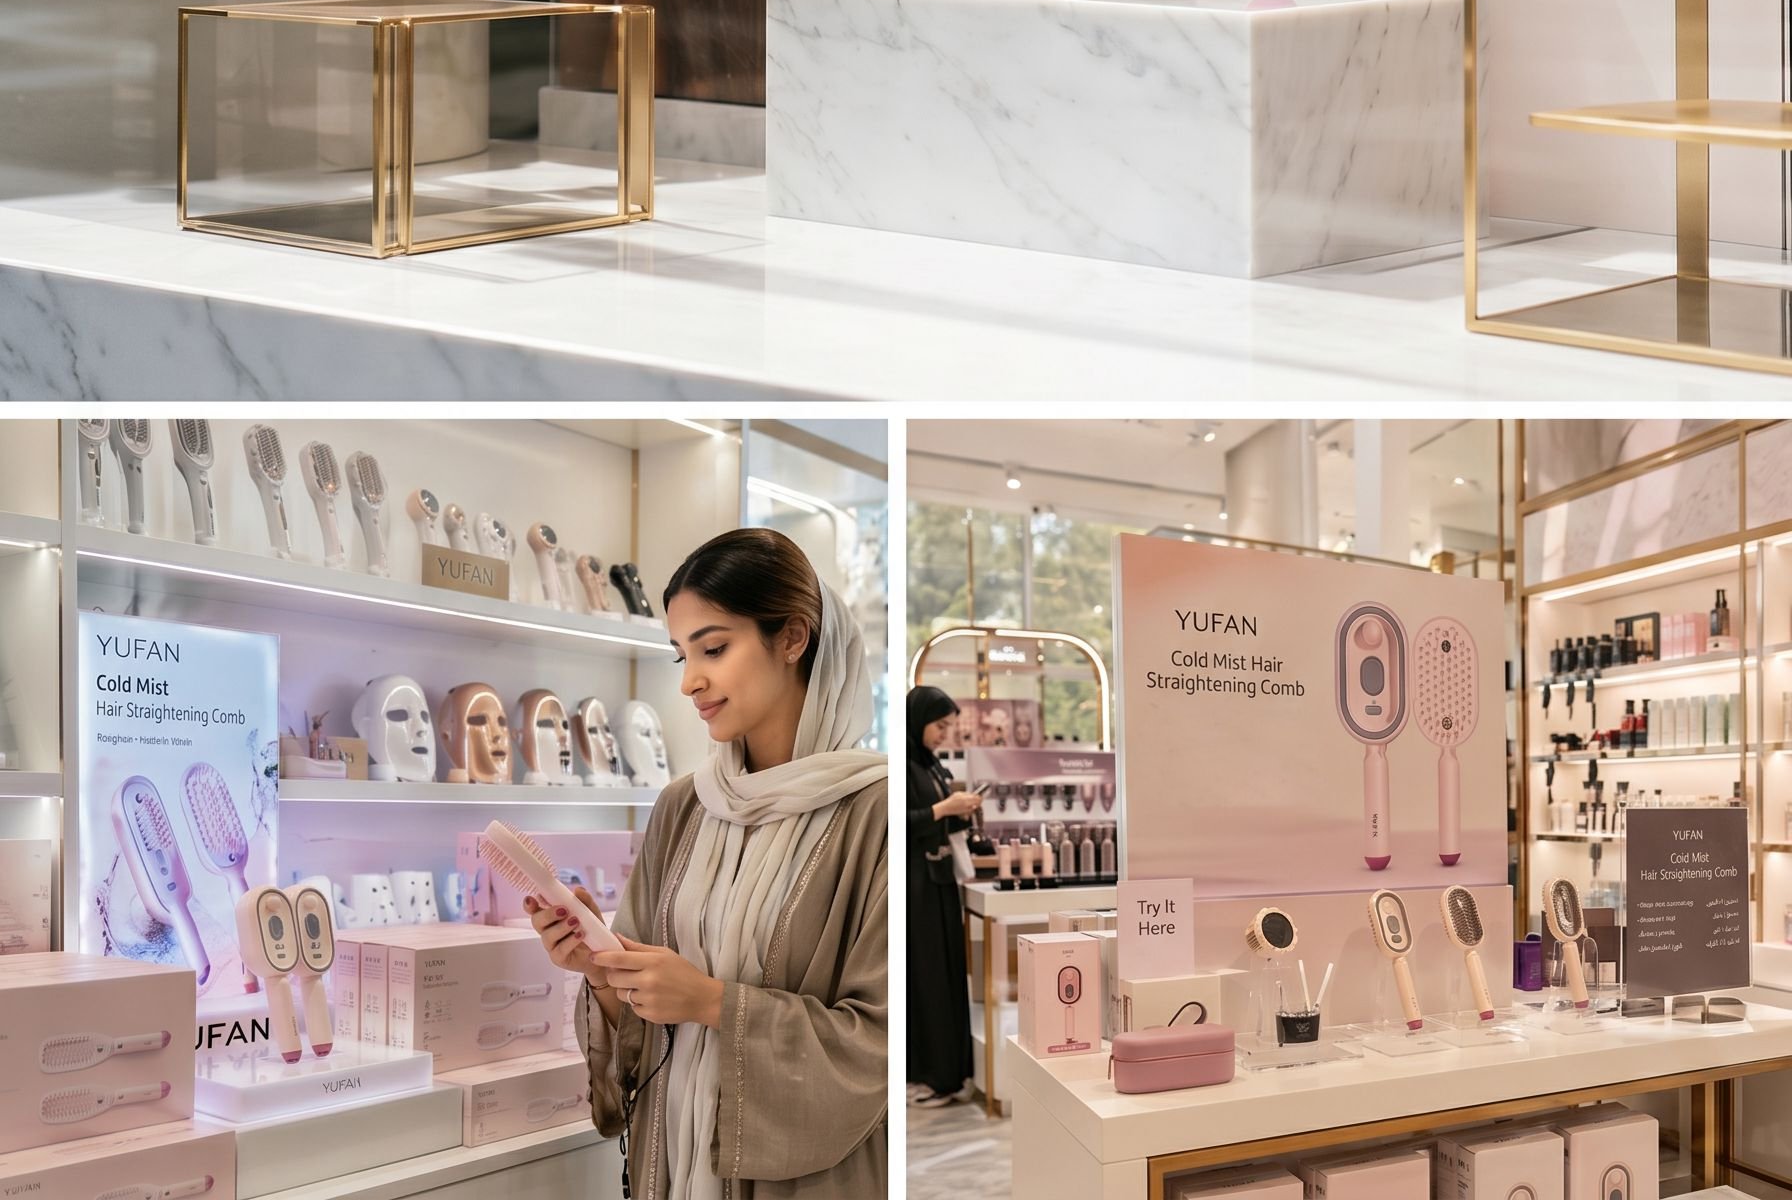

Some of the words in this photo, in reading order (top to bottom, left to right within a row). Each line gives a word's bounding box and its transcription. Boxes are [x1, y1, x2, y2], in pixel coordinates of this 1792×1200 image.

[437, 557, 494, 586] YUFAN
[1174, 609, 1257, 637] YUFAN
[96, 634, 180, 663] YUFAN
[1171, 650, 1208, 668] Cold
[1213, 653, 1247, 671] Mist
[1251, 655, 1284, 673] Hair
[96, 674, 131, 693] Cold
[136, 677, 169, 696] Mist
[1146, 671, 1256, 699] Straightening
[1260, 679, 1305, 697] Comb
[96, 700, 123, 717] Hair
[126, 702, 208, 727] Straightening
[212, 708, 246, 725] Comb
[1672, 830, 1704, 840] YUFAN
[1692, 851, 1710, 863] Mist
[1640, 869, 1658, 881] Hair
[1714, 866, 1738, 878] Comb
[1137, 900, 1161, 917] Try
[1165, 899, 1176, 914] It
[1138, 921, 1176, 936] Here
[322, 1076, 362, 1094] YUFAN
